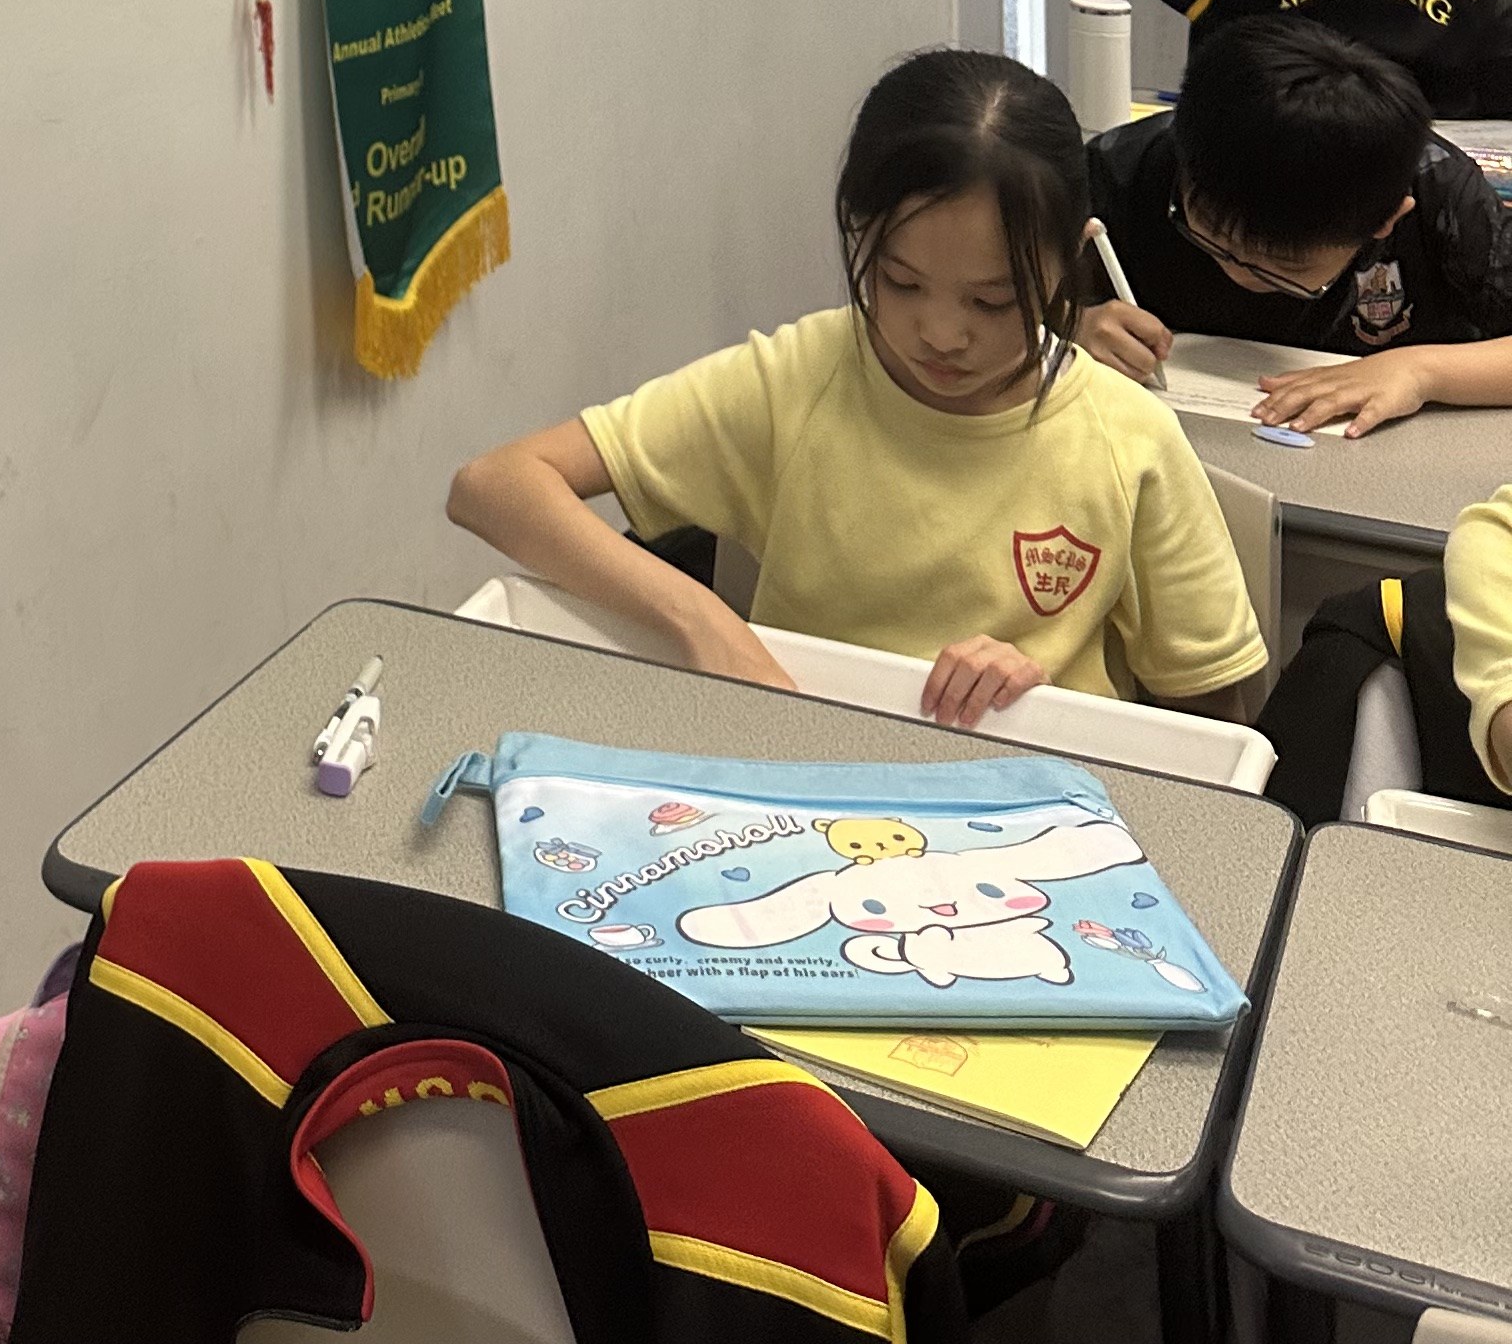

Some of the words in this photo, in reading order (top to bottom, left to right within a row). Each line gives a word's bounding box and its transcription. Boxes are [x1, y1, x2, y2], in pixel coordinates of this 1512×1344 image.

[333, 30, 382, 62] Annual
[556, 814, 805, 924] Cinnamoroll
[697, 955, 751, 967] creamy
[756, 955, 783, 966] and
[686, 966, 722, 978] with
[724, 969, 735, 978] a
[739, 966, 771, 980] flap
[773, 967, 790, 979] of
[793, 967, 818, 978] his
